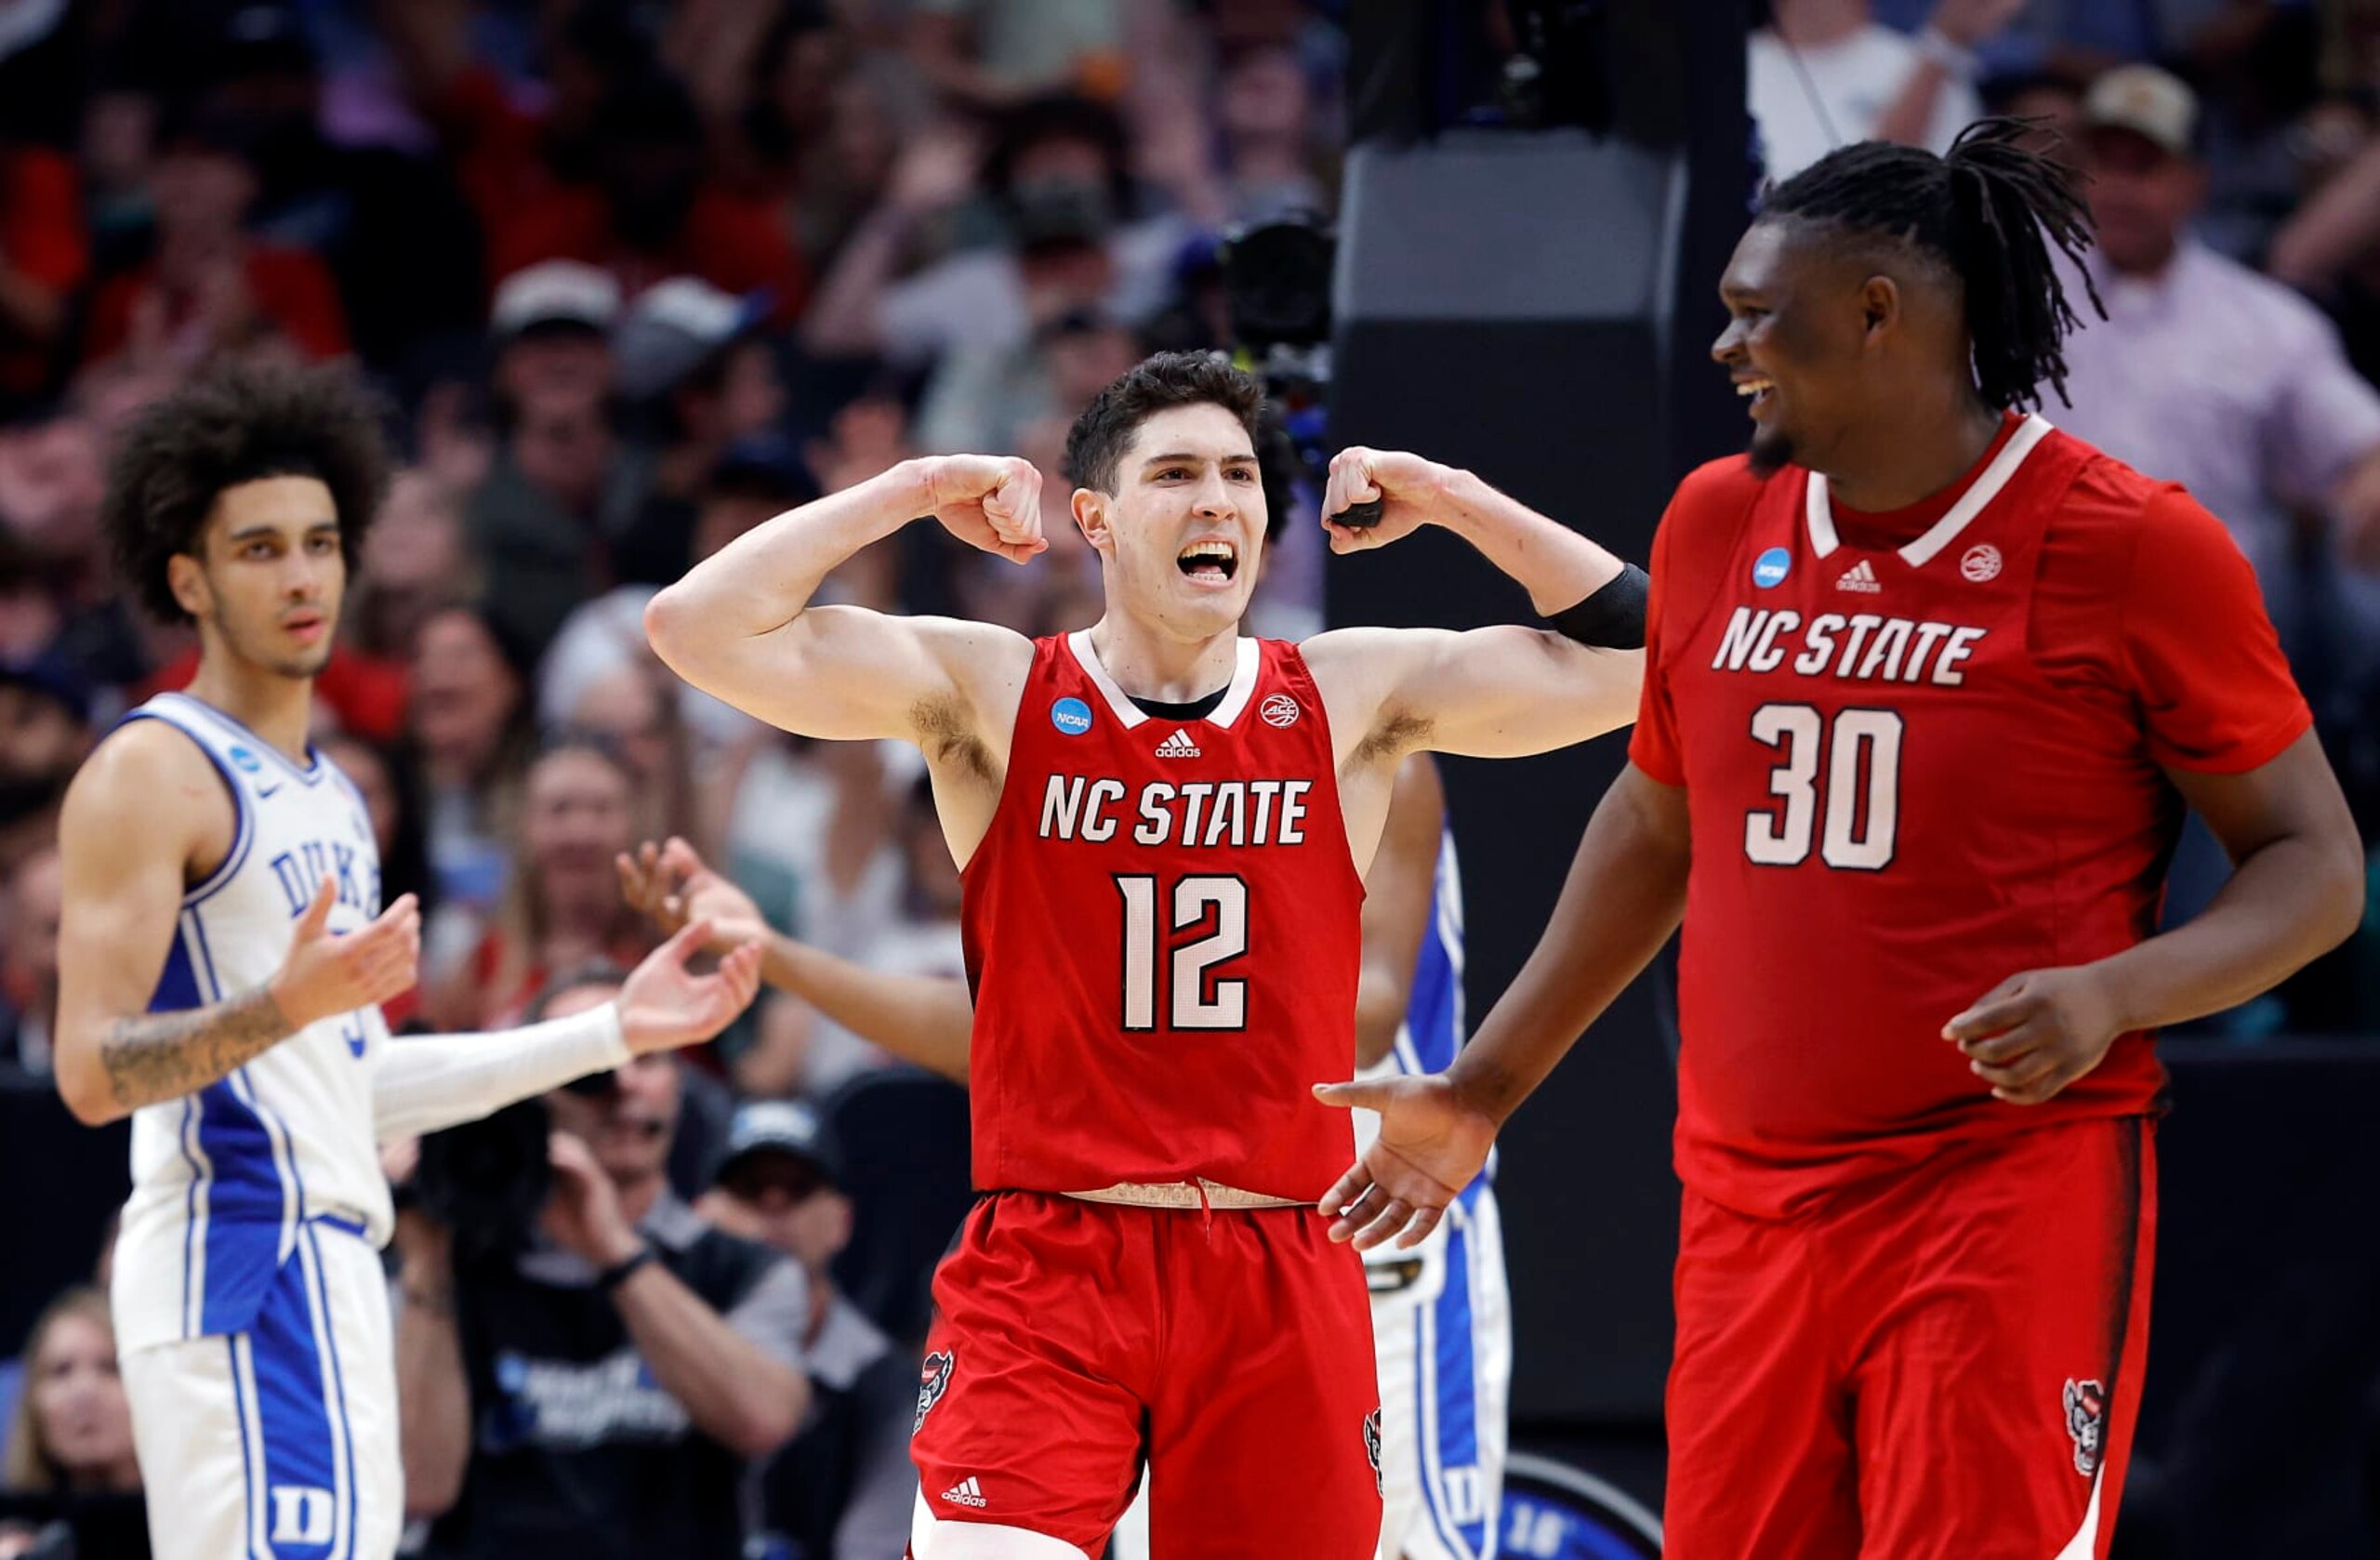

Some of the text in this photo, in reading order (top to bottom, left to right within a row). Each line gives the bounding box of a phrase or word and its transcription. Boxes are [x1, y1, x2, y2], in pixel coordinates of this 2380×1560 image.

[1711, 605, 1989, 686] NC STATE
[1056, 712, 1089, 728] NCAA
[1156, 746, 1200, 758] adidas
[1038, 773, 1313, 846] NC STATE
[1744, 703, 1904, 872] 30
[1112, 874, 1250, 1032] 12
[271, 1486, 334, 1543] D
[941, 1491, 986, 1508] adidas
